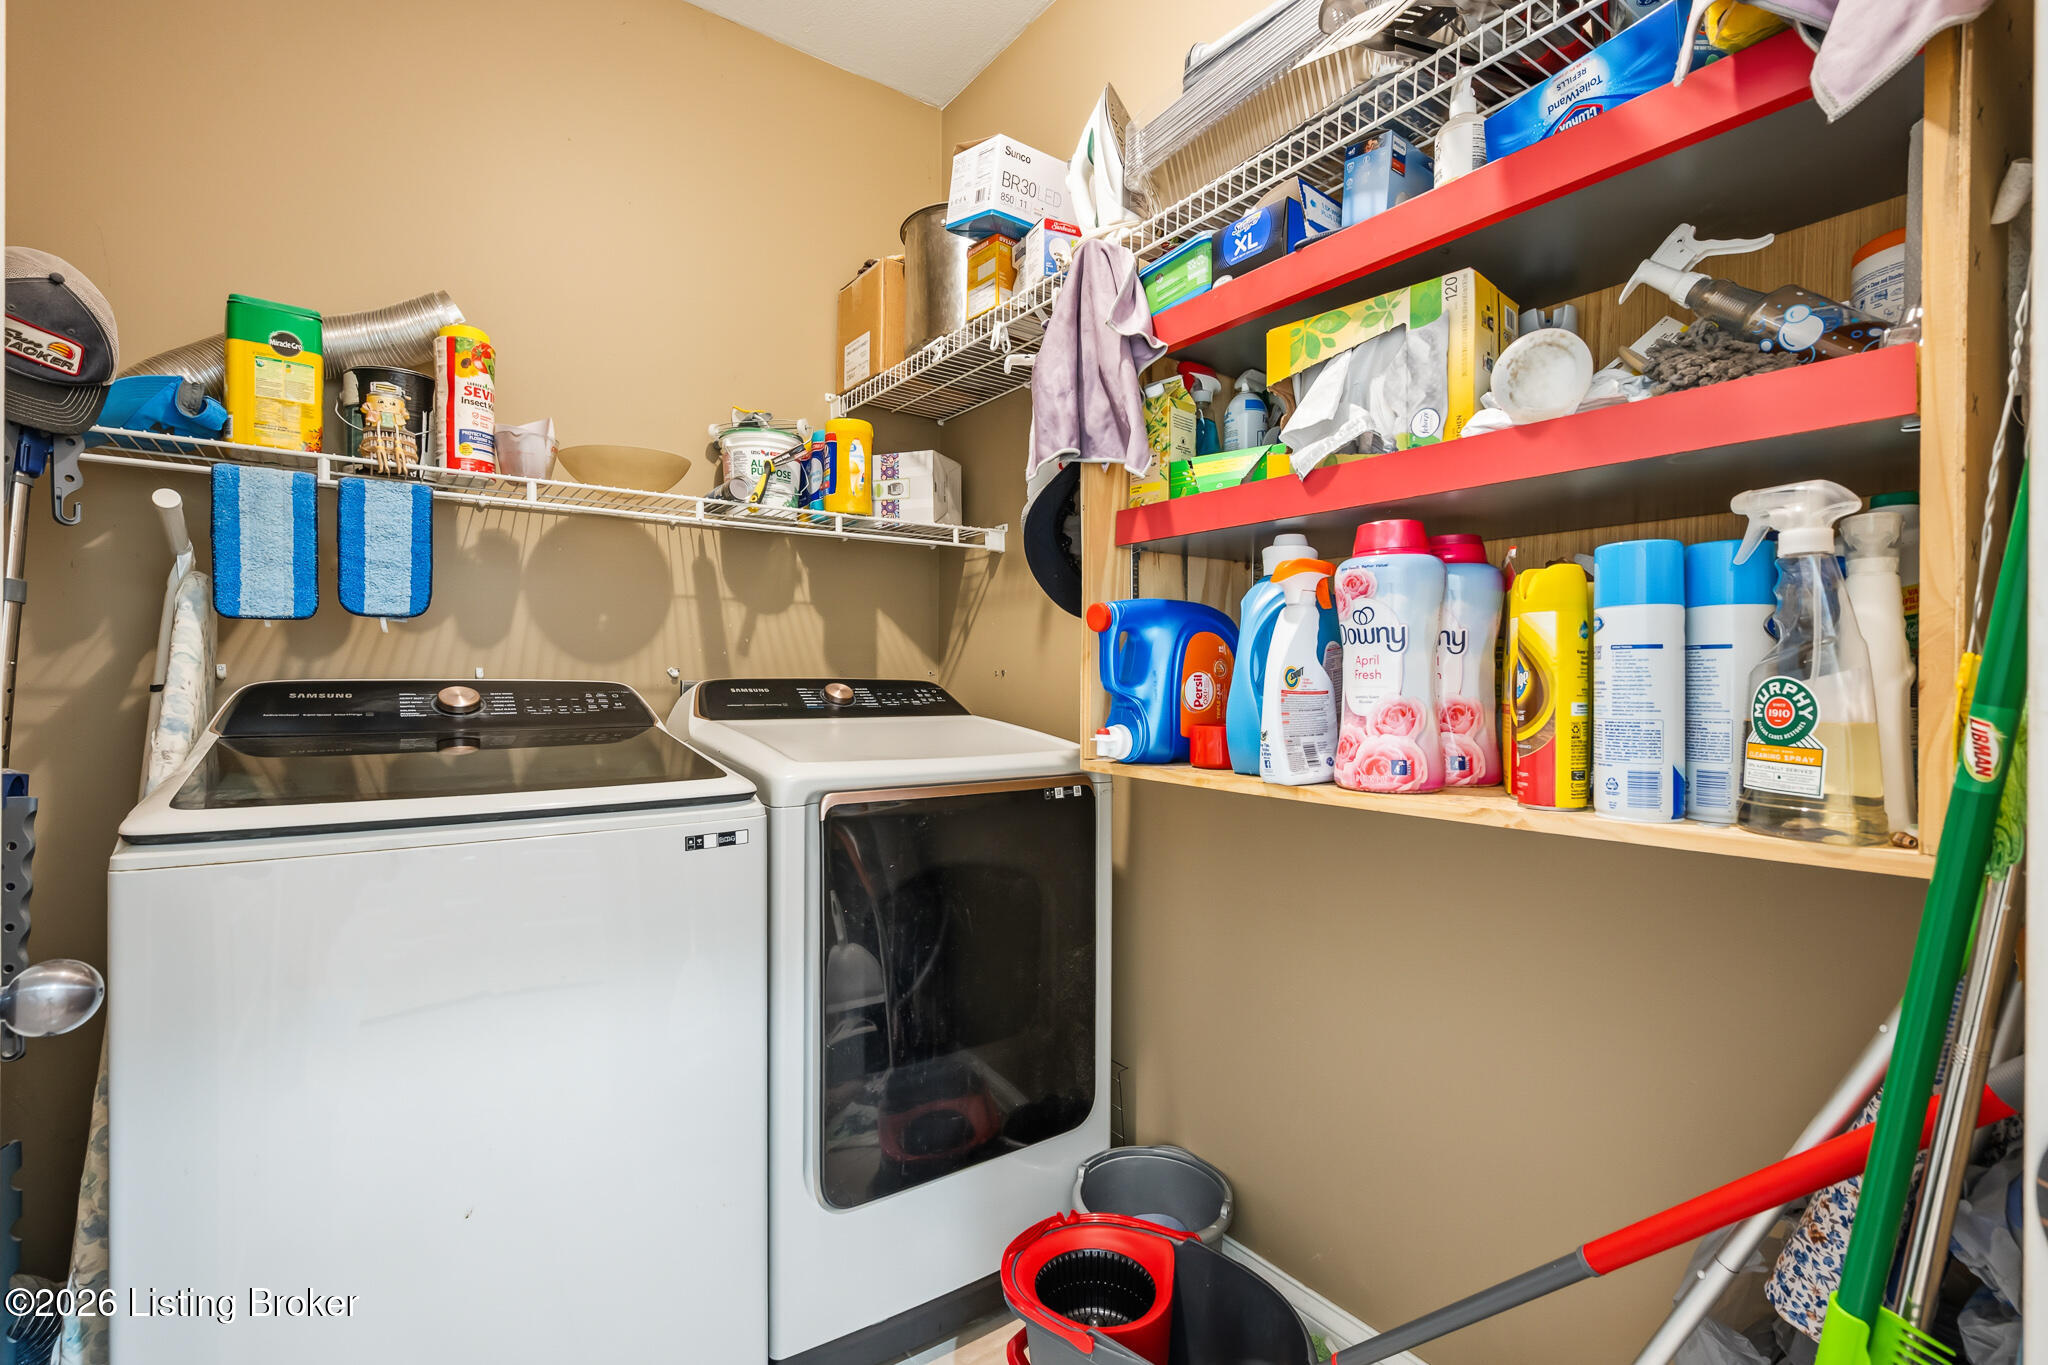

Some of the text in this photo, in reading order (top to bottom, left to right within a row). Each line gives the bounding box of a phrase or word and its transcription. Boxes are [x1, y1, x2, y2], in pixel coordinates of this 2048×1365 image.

[1556, 67, 1587, 91] REFILLS
[1547, 75, 1603, 115] ToiletWand
[1005, 145, 1031, 164] Sunco
[1001, 170, 1037, 198] BR30
[1000, 192, 1027, 209] 850 11
[1234, 232, 1258, 256] XL
[1444, 276, 1458, 301] 120
[5, 337, 74, 371] ACKER
[269, 338, 303, 351] Miracle-Gro
[461, 396, 488, 409] Insect
[751, 467, 792, 479] PUOSE
[1355, 654, 1380, 669] April
[1354, 669, 1382, 680] Fresh
[1193, 674, 1204, 708] Persil
[1754, 681, 1814, 721] MURPHY
[1768, 708, 1791, 718] 1910
[1969, 718, 1992, 778] LIBMAN
[1783, 754, 1816, 764] SPRAY
